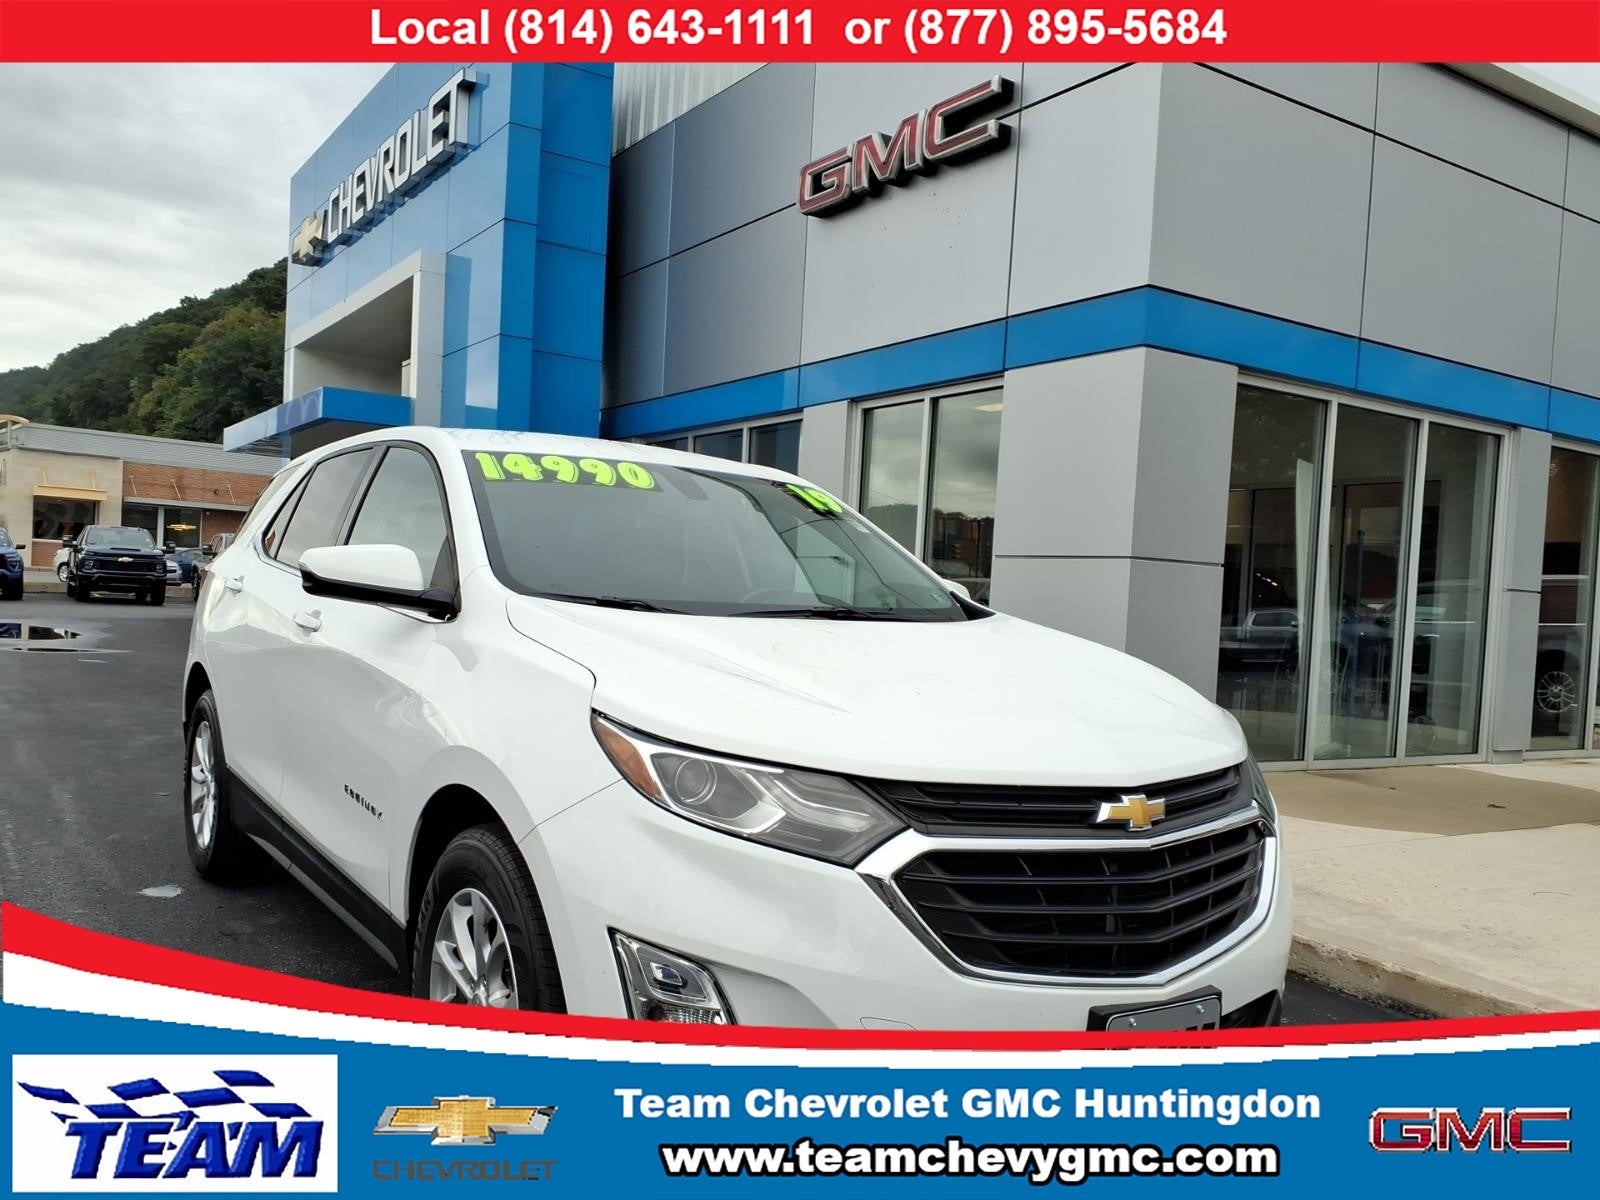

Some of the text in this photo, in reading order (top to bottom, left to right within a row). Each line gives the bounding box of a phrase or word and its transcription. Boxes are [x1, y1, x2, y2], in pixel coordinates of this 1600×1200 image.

[327, 67, 468, 243] CHEVROLET
[796, 73, 1004, 215] GMC
[475, 452, 655, 490] 14990
